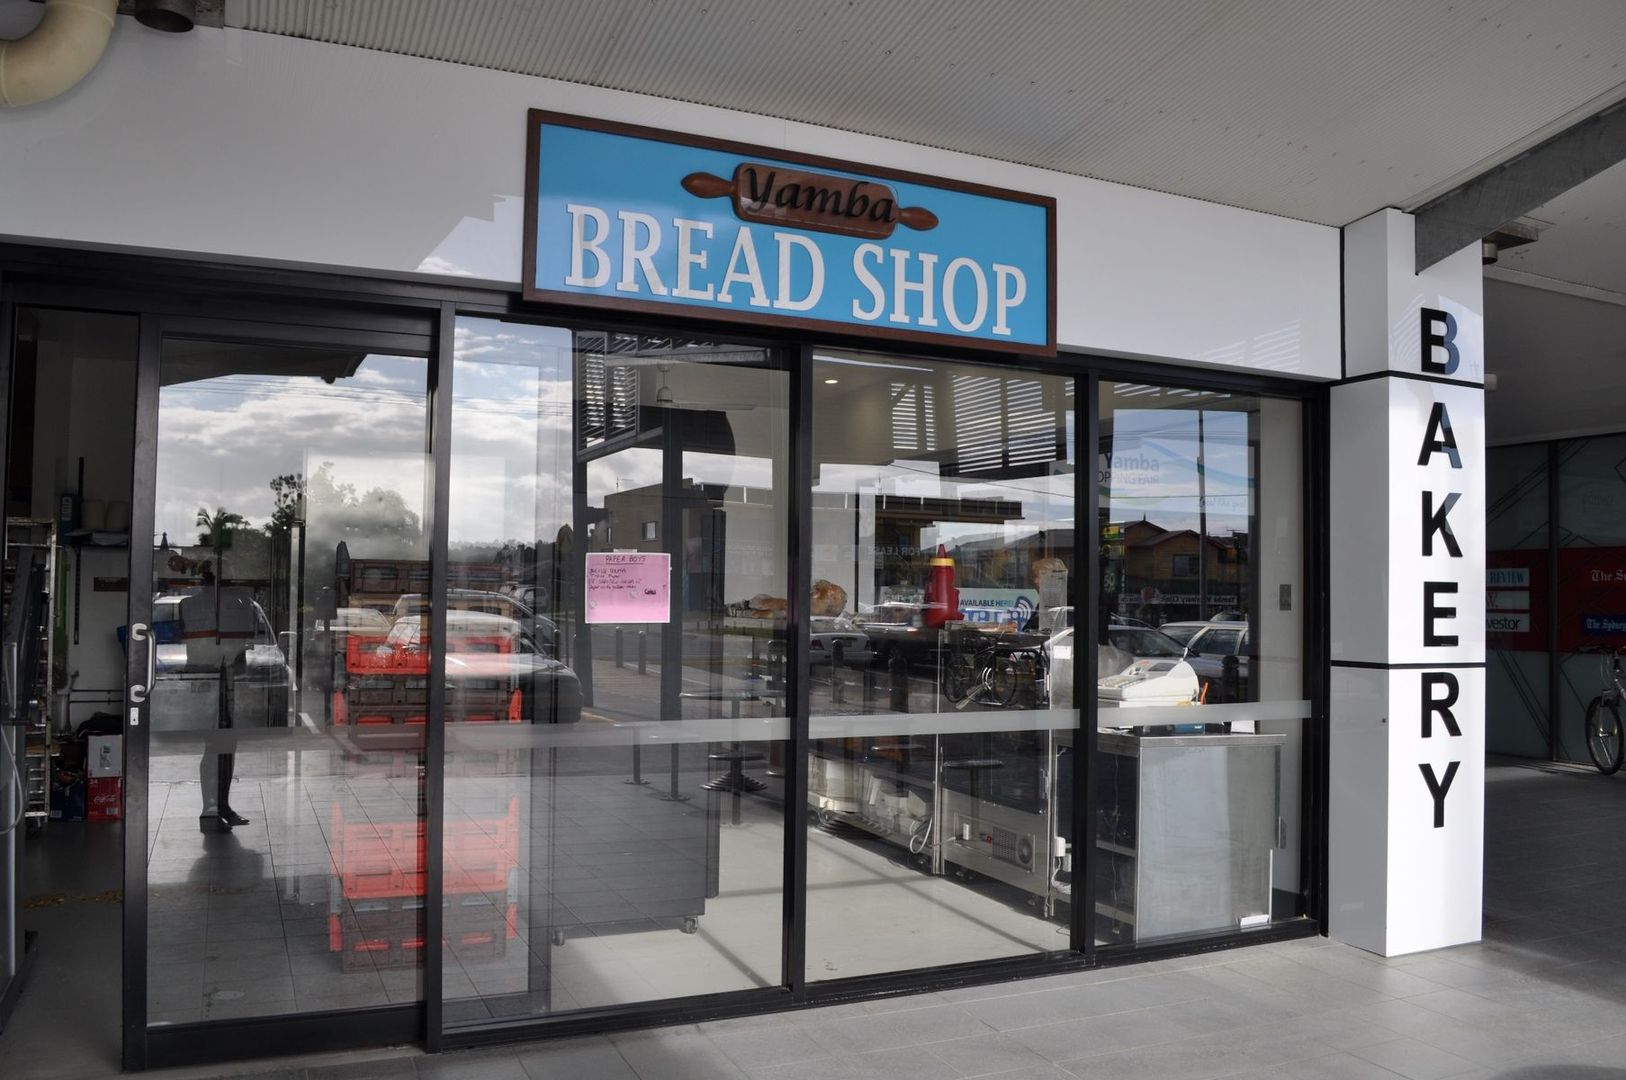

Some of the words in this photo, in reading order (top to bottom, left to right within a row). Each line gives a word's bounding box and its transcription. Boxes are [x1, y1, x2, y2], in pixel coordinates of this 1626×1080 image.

[742, 166, 898, 224] Yamba
[564, 203, 826, 311] BREAD
[852, 243, 1027, 336] SHOP
[1103, 453, 1159, 472] Yamba
[1417, 307, 1463, 829] BAKERY
[1591, 569, 1611, 582] The
[960, 599, 995, 607] AVAILABLE
